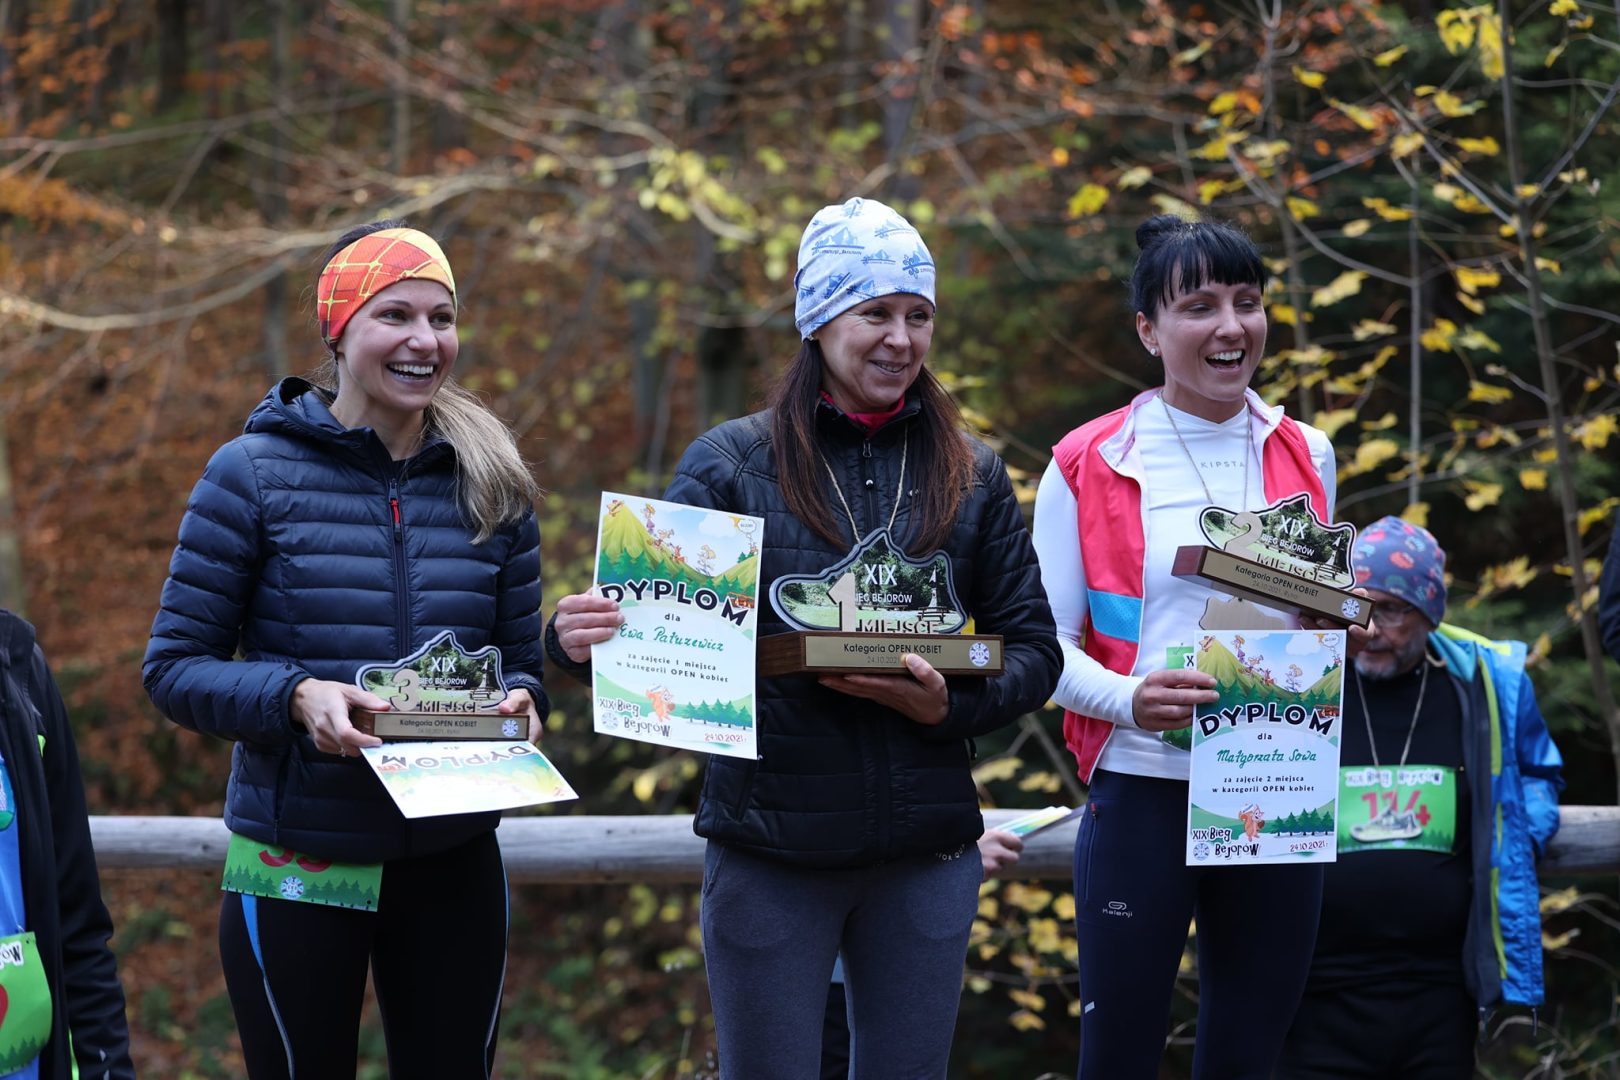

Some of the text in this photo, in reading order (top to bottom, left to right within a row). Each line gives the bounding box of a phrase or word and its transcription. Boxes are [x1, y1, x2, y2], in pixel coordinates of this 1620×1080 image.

[1200, 461, 1245, 469] KIPSTA
[1224, 511, 1263, 559] 2
[1278, 514, 1308, 540] XIX
[1279, 539, 1315, 557] BEJORÓW
[864, 563, 898, 586] XIX
[1235, 564, 1319, 598] Kategoria OPEN KOBIET
[601, 578, 750, 627] DYPLOM
[826, 572, 857, 632] 1
[855, 591, 913, 604] IEG BEJORÓW
[664, 612, 681, 622] dla
[620, 623, 644, 641] Ewa
[859, 618, 940, 635] MIEJSCE
[844, 643, 942, 655] Kategoria OPEN KOBIET
[431, 656, 457, 673] XIX
[626, 662, 667, 675] kategorii
[671, 668, 696, 678] OPEN
[700, 673, 729, 683] kobiet
[684, 661, 717, 672] miejsca
[435, 675, 468, 685] BEJORÓW
[389, 668, 419, 712] 3
[420, 700, 481, 712] MIEJSCE
[617, 699, 640, 718] Bieg
[400, 719, 477, 728] Kategoria OPEN KOBIET
[1199, 703, 1334, 738] DYPLOM
[1257, 732, 1272, 740] dla
[1288, 748, 1317, 762] Sowa
[1235, 775, 1263, 784] zajęcie
[1266, 775, 1271, 783] 2
[1275, 775, 1305, 783] miejsca
[1222, 786, 1259, 794] kategorii
[1192, 827, 1231, 842] XIX Bieg
